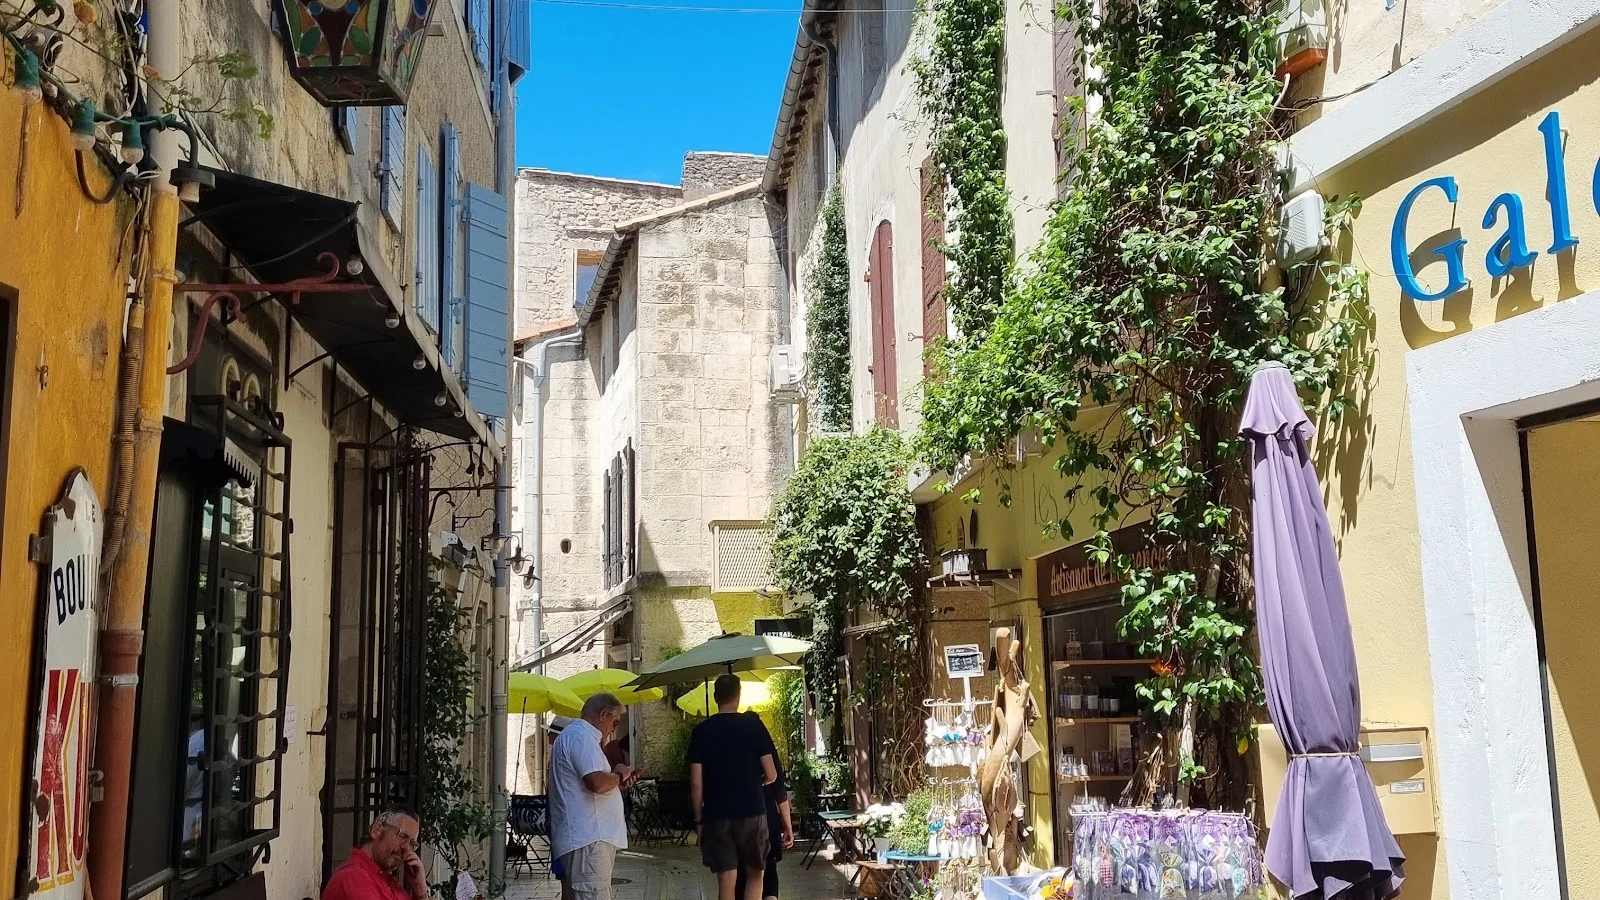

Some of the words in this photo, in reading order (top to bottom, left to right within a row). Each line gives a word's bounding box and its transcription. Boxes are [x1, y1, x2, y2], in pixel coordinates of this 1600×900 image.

[1391, 111, 1600, 301] Gal
[1050, 559, 1095, 597] Artisanat
[1094, 557, 1110, 587] de
